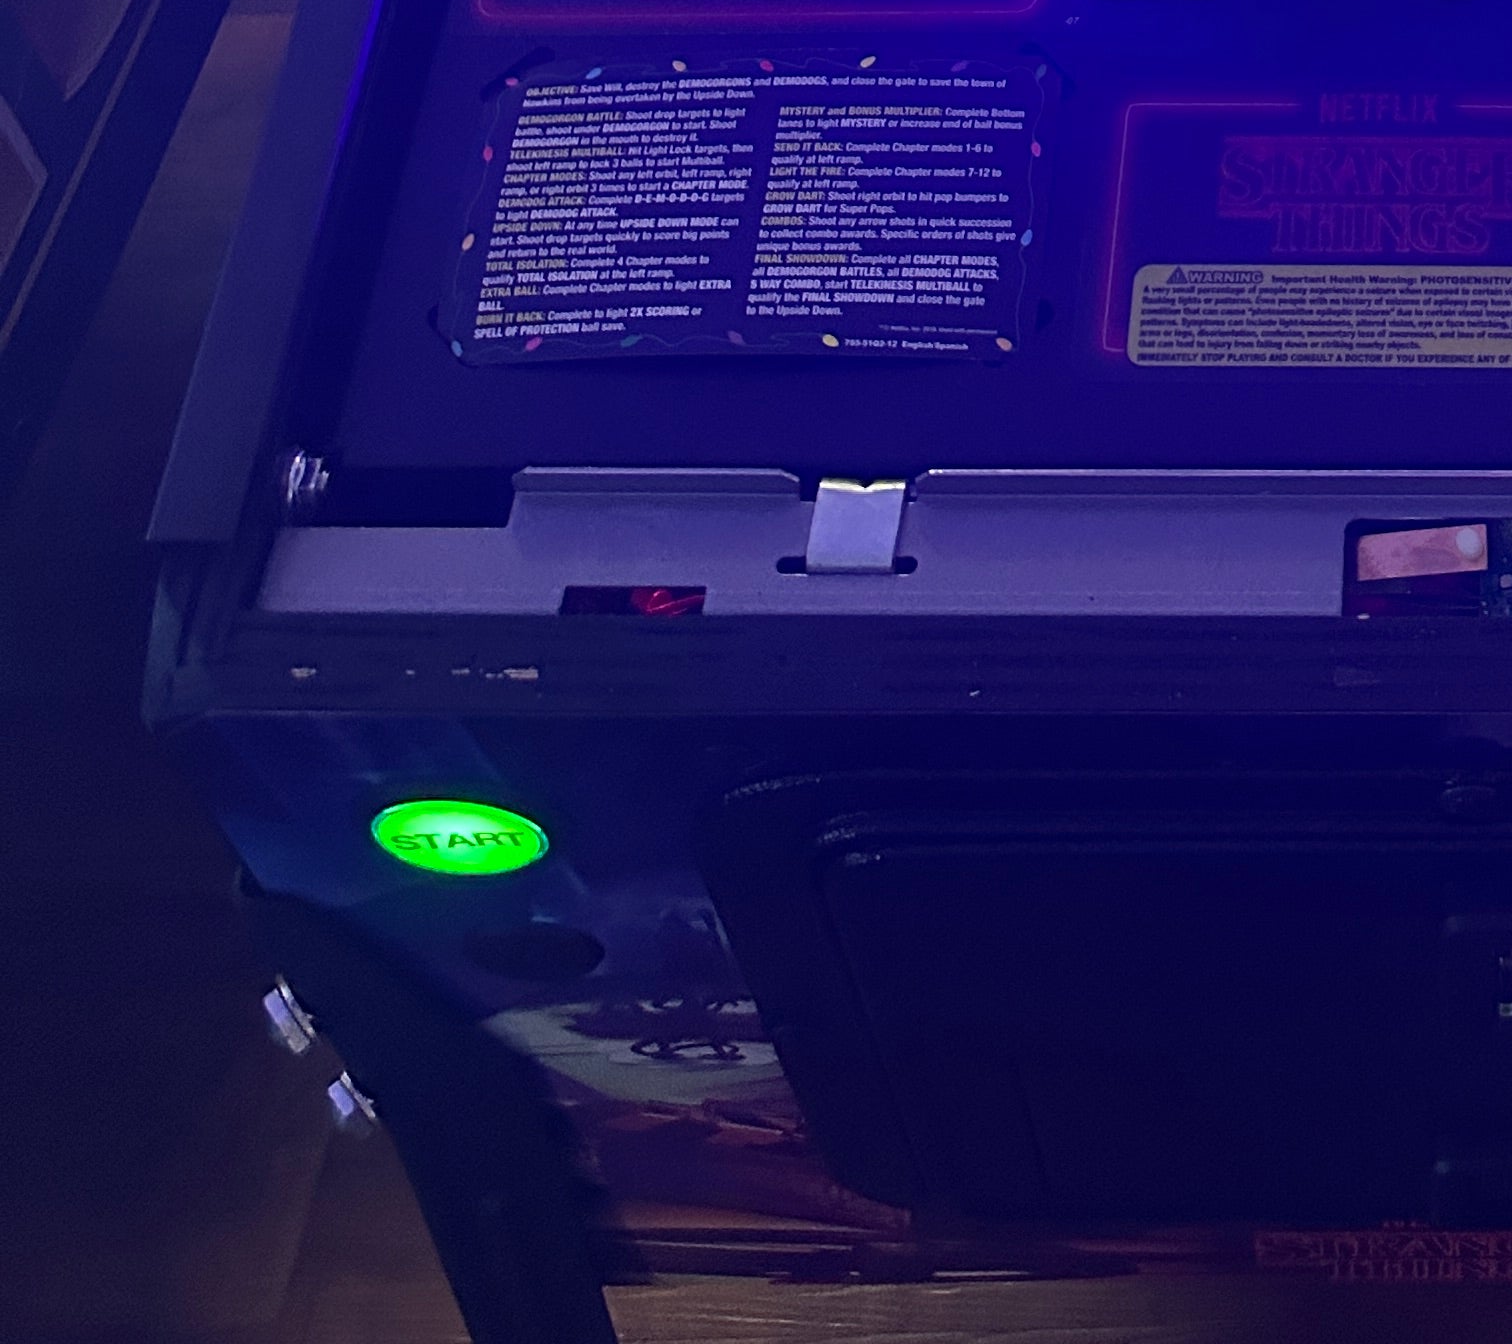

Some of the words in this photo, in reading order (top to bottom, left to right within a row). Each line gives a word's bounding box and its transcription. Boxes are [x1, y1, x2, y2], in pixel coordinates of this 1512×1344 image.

[1319, 93, 1439, 124] NETFLIX
[846, 142, 890, 153] Complete
[892, 143, 930, 154] Chapter
[848, 167, 893, 178] Complete
[895, 167, 931, 178] Chapter
[619, 218, 655, 230] UPSIDE
[657, 217, 688, 229] DOWN
[690, 216, 719, 228] MODE
[1272, 201, 1492, 254] THINGS
[912, 255, 959, 266] CHAPTER
[1187, 270, 1264, 285] WARNING
[1271, 274, 1327, 285] Important
[1329, 274, 1366, 284] Health
[390, 828, 526, 852] START
